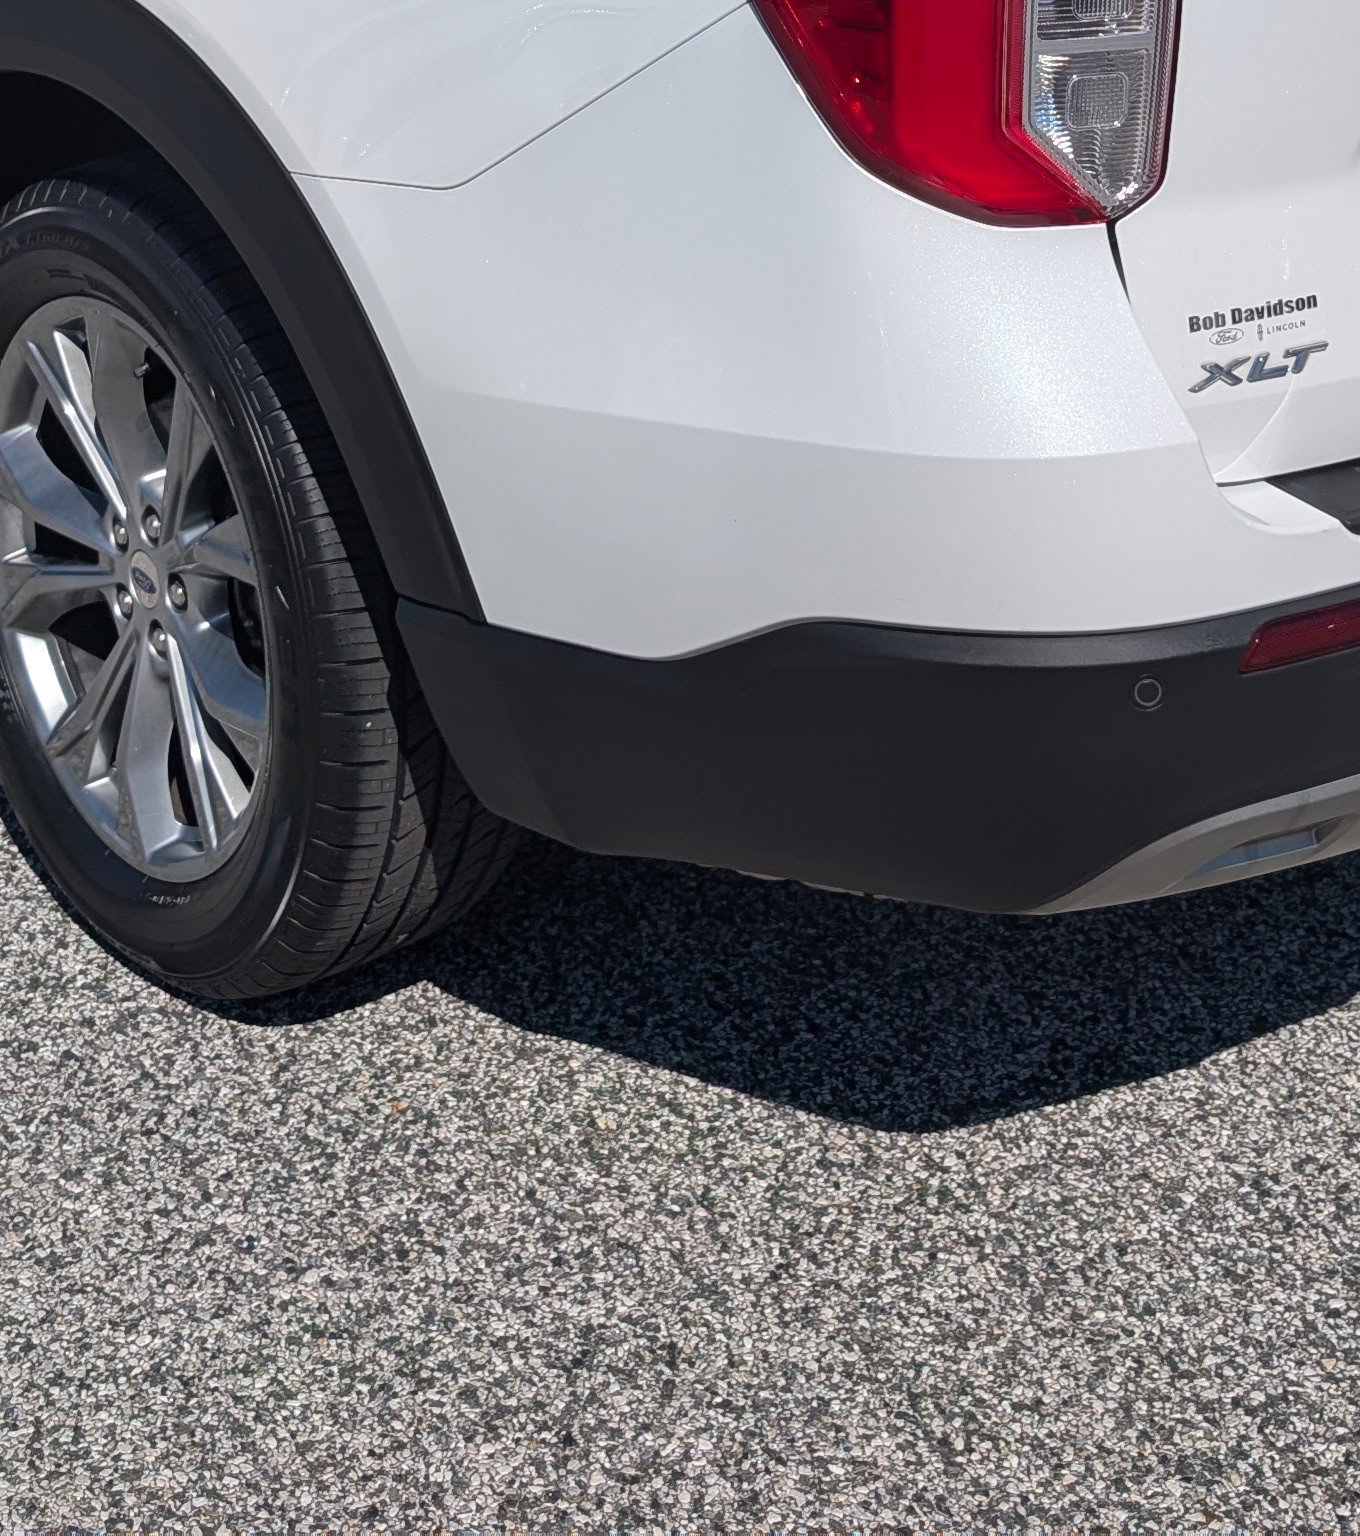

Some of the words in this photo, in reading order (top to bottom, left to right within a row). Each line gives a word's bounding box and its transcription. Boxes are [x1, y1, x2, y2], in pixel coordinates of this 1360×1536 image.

[1187, 311, 1227, 333] Bob
[1230, 294, 1318, 325] Davidson
[1266, 319, 1307, 334] LINCOLN
[1215, 330, 1239, 344] Ford
[1187, 340, 1330, 394] XLT
